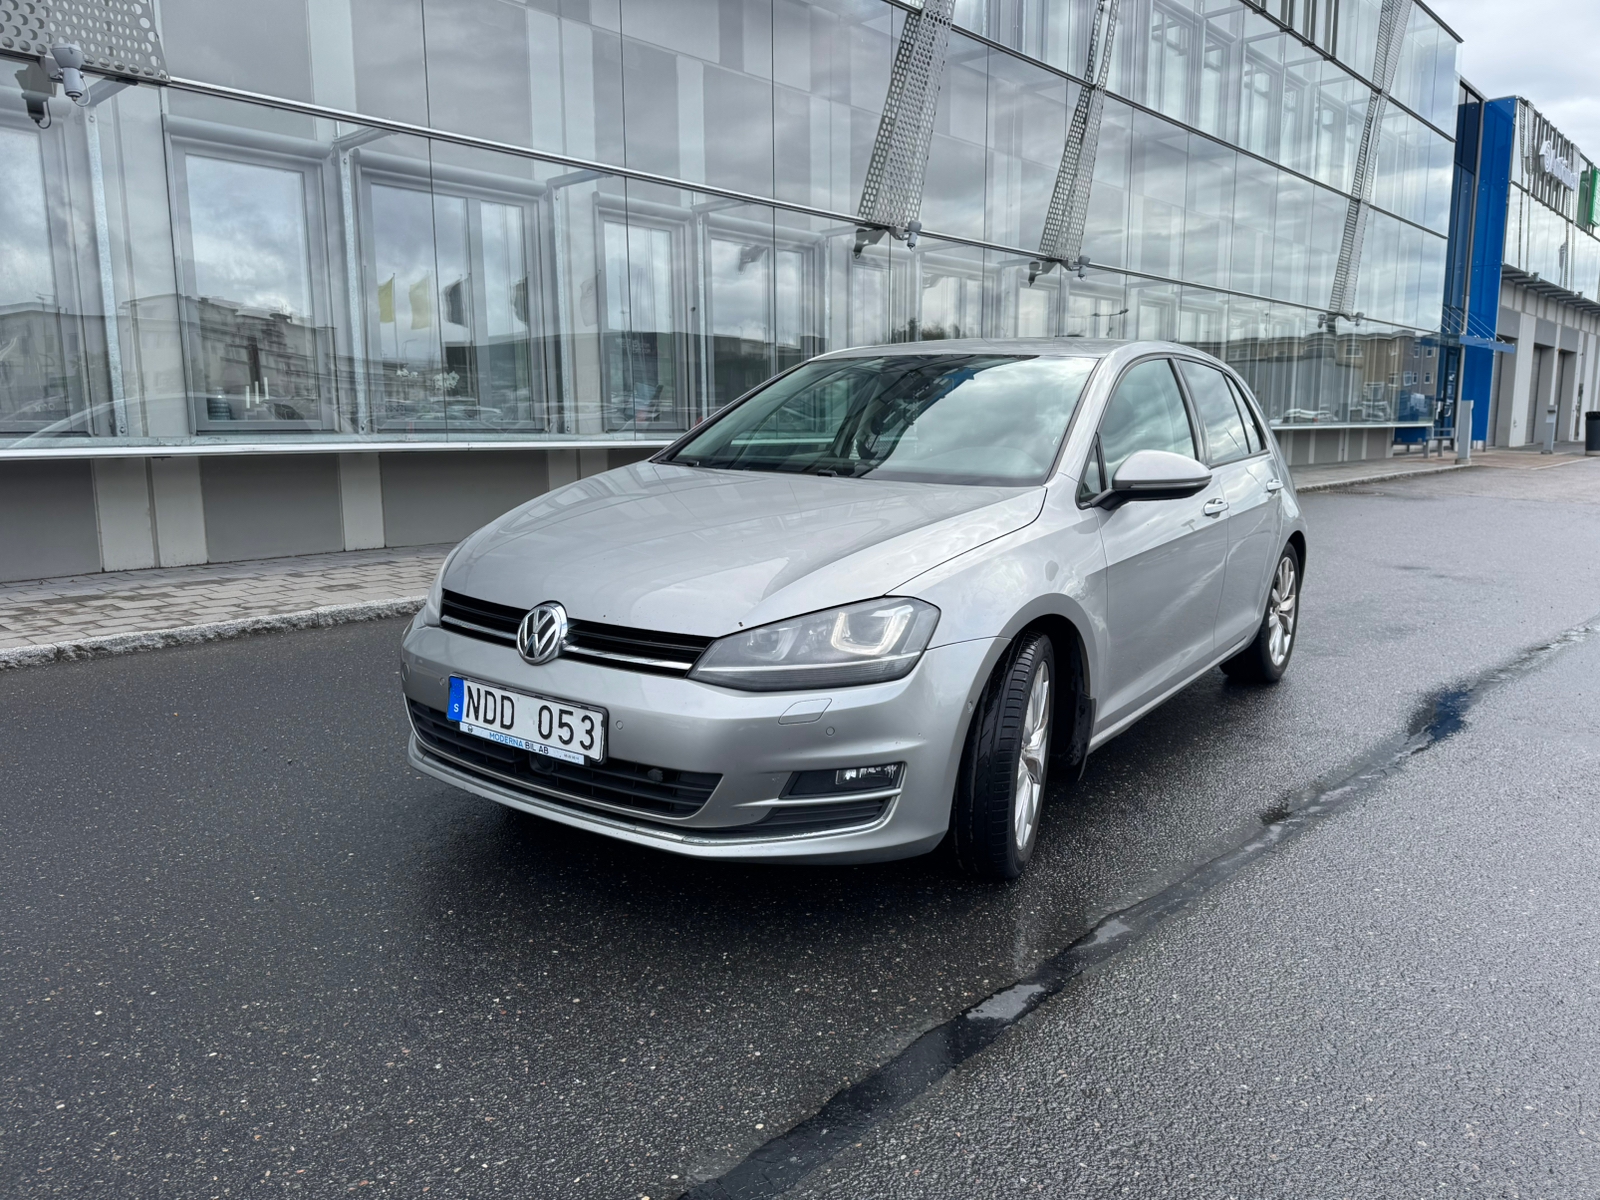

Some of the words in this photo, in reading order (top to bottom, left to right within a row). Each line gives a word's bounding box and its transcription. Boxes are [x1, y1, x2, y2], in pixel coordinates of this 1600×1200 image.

[453, 703, 460, 713] S
[466, 685, 515, 730] NDD
[538, 705, 595, 750] 053
[489, 733, 523, 747] MODERNA
[525, 742, 536, 751] BIL
[538, 746, 549, 754] AB
